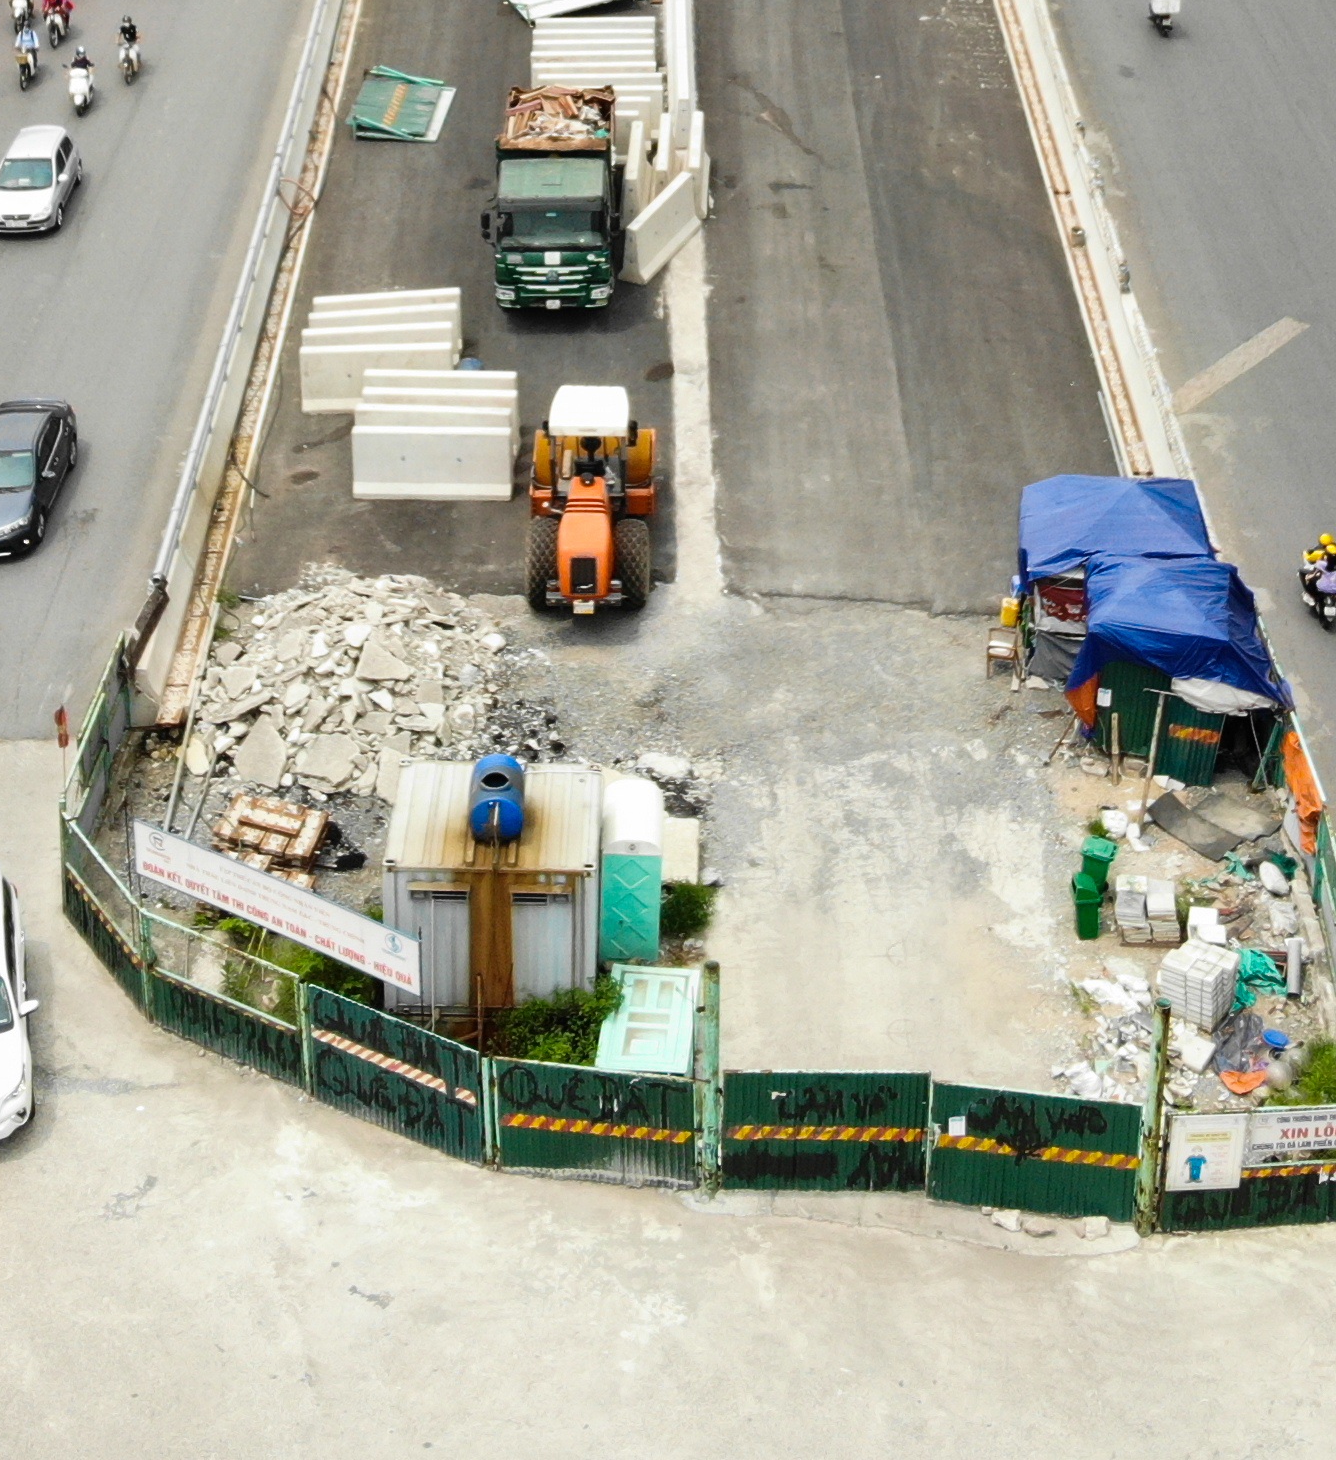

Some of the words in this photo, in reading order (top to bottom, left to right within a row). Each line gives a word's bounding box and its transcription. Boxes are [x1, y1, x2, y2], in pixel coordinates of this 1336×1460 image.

[232, 898, 244, 913] THI
[246, 903, 269, 922] CÔNG
[285, 921, 307, 938] TOÀN
[315, 934, 336, 952] CHẤT
[1280, 1127, 1309, 1140] XIN
